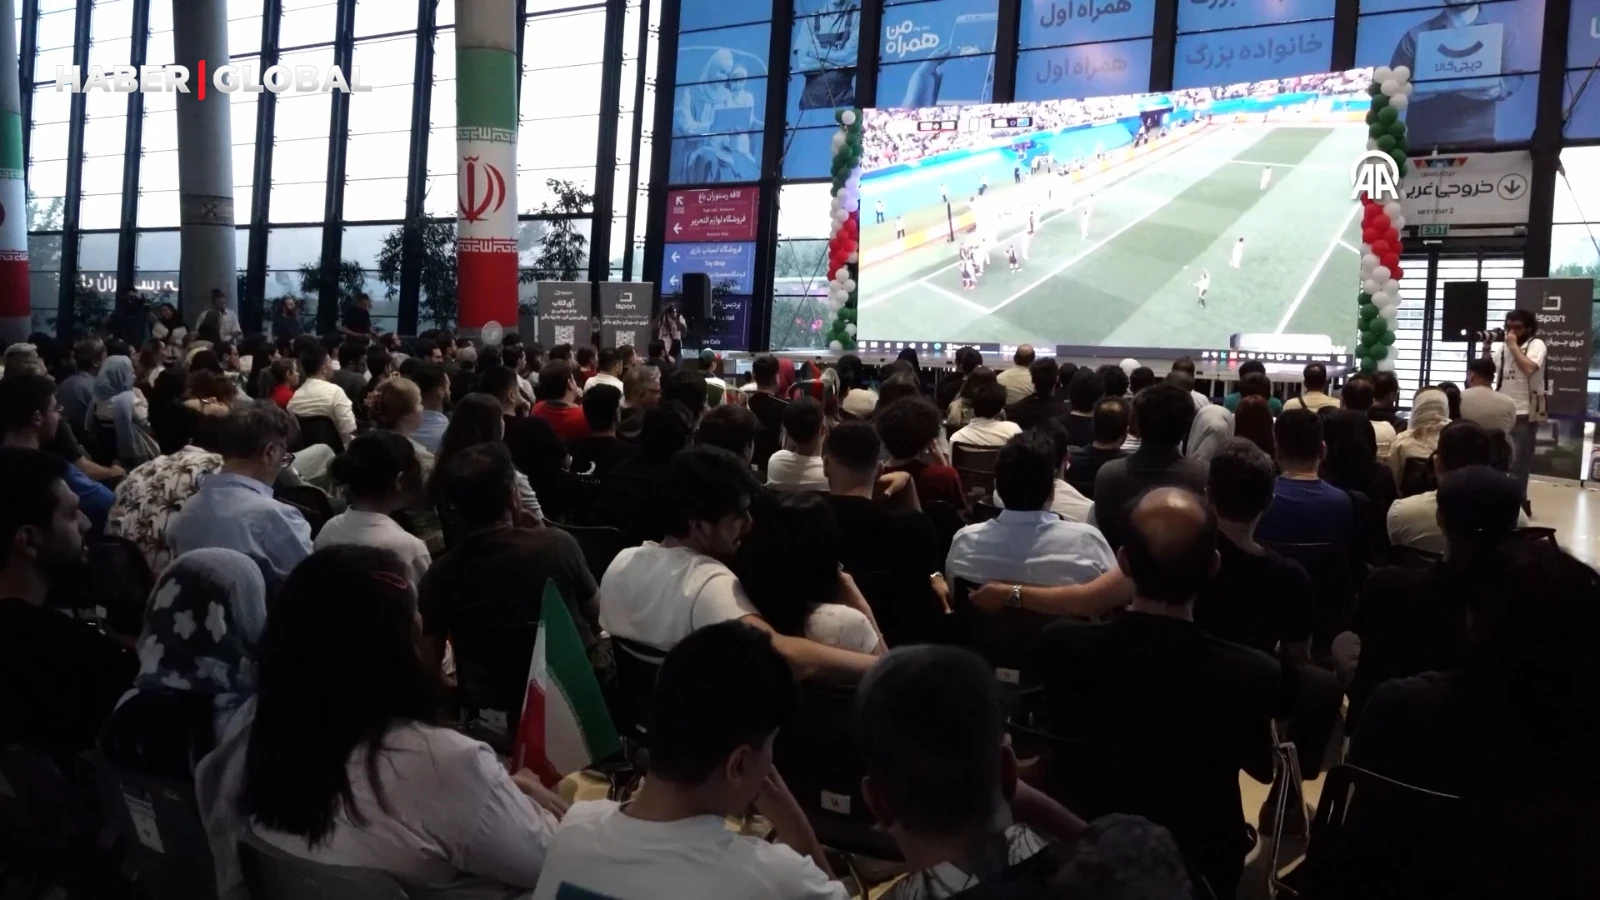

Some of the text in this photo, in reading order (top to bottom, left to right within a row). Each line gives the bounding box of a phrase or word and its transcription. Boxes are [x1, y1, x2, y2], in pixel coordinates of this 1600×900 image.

[1040, 0, 1131, 28] همراه اول
[886, 20, 913, 40] من
[886, 33, 940, 58] همراه
[1186, 33, 1323, 69] خانواده بزرگ
[1036, 56, 1127, 84] همراه اول
[698, 189, 741, 203] کافه رستوران باغ
[1435, 180, 1494, 198] خروجی
[690, 214, 746, 227] فروشگاه لوازم التحریر
[1422, 225, 1446, 235] EXIT
[690, 244, 742, 255] فروشگاه اسباب بازی
